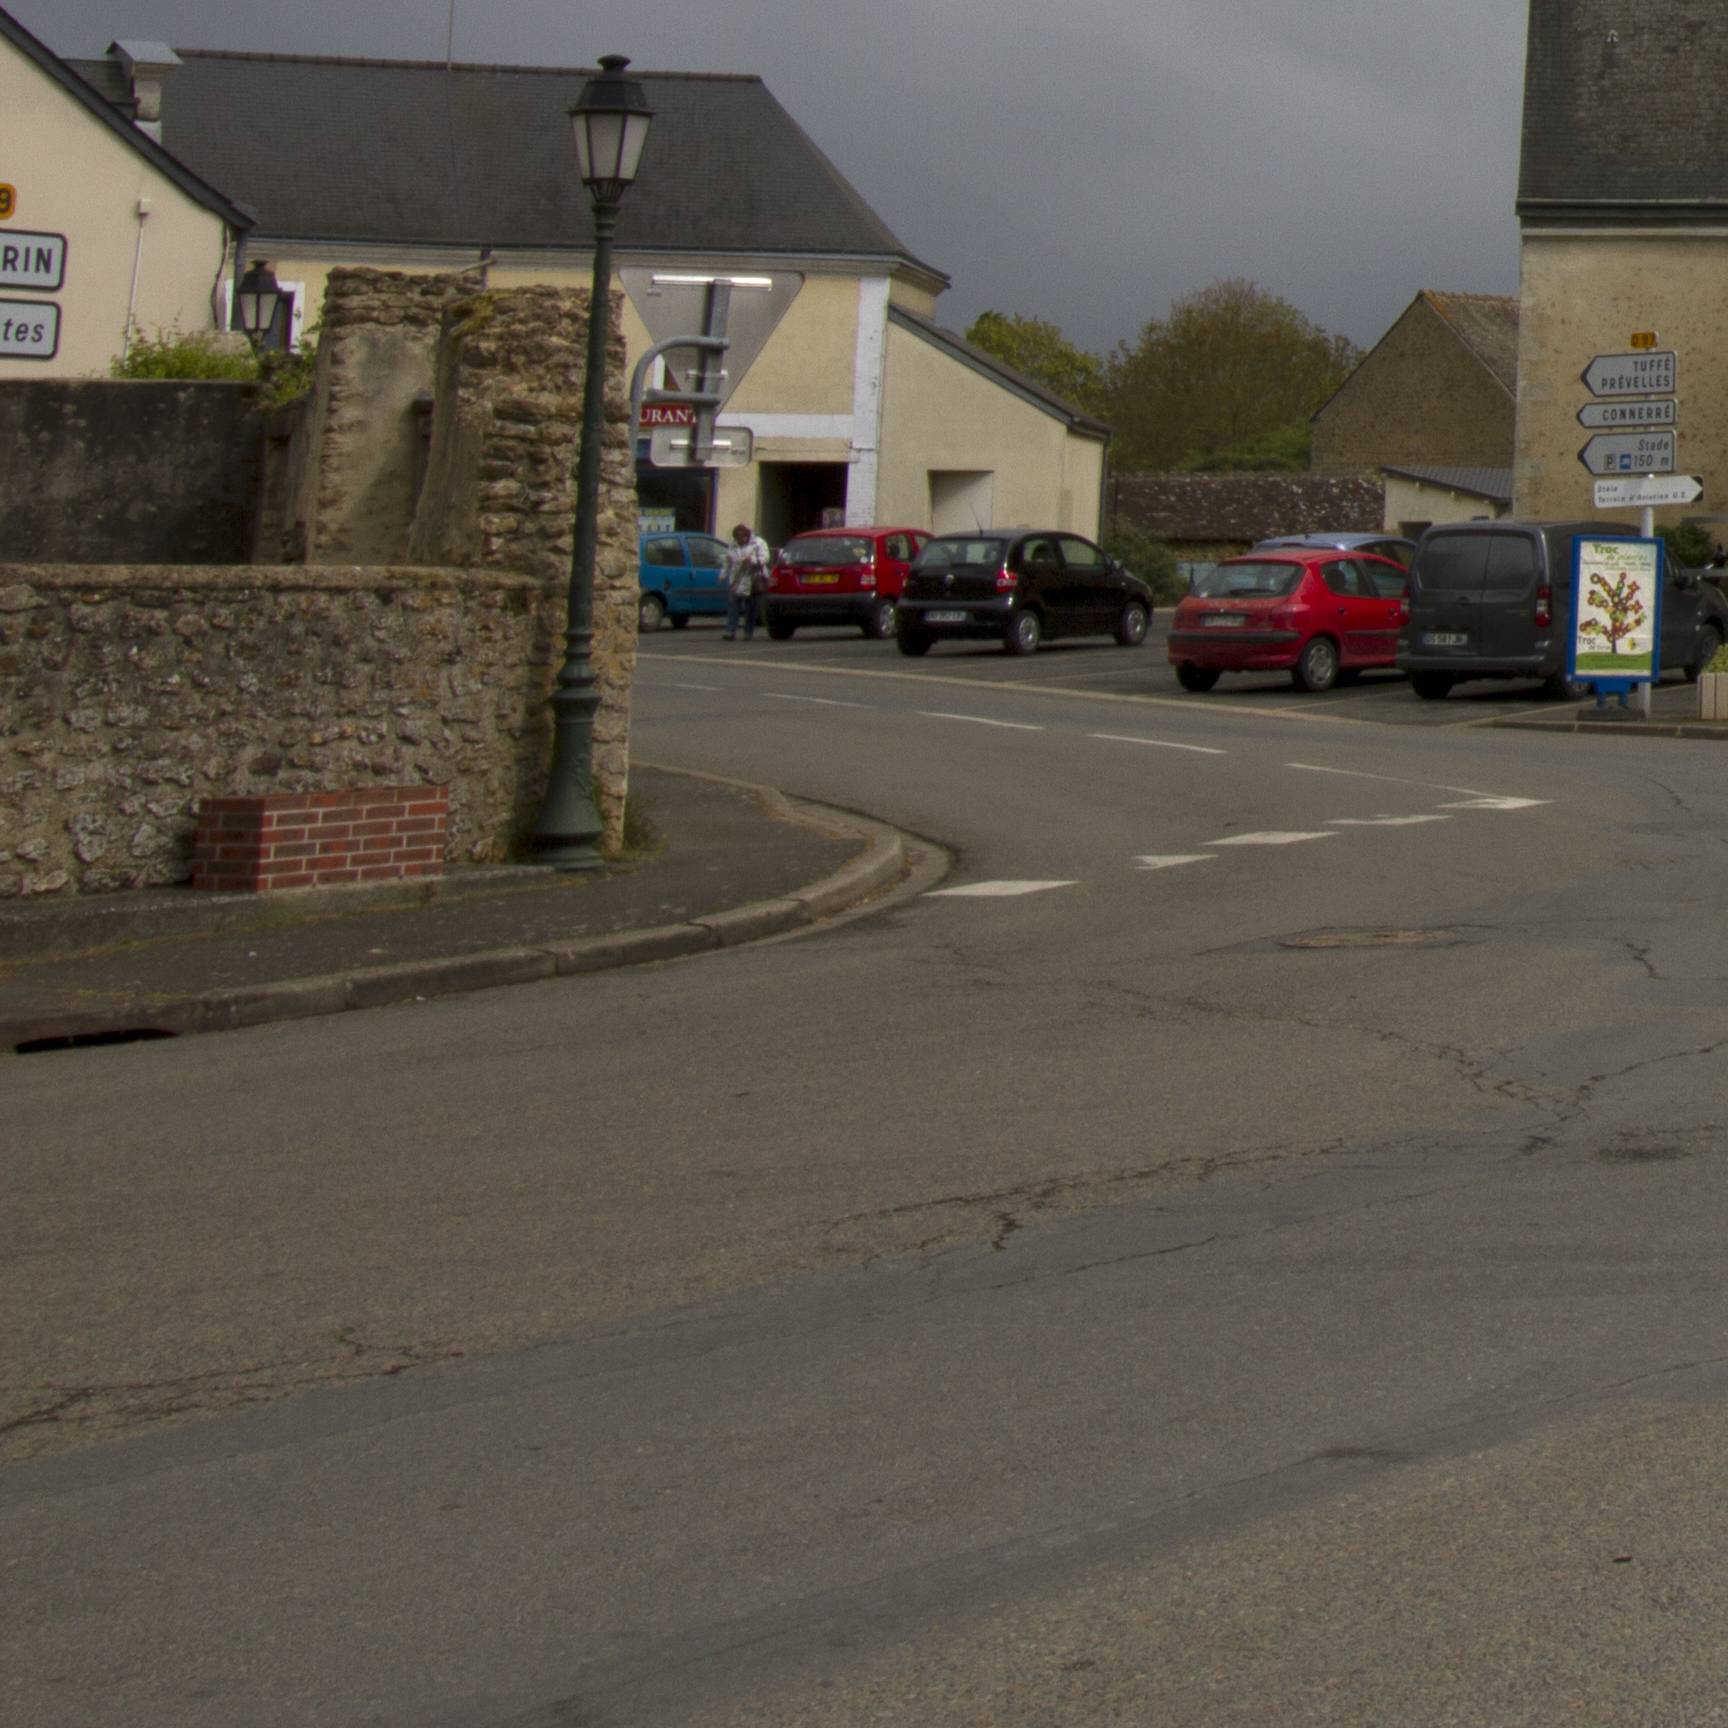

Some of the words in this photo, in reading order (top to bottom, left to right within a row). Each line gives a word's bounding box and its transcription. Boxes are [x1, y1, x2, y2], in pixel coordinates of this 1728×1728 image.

[1633, 356, 1671, 372] TUFFÉ
[1601, 374, 1670, 390] PRÉVELLES
[1602, 404, 1670, 421] CONNERRÉ
[1638, 438, 1669, 452] Stade
[1634, 454, 1653, 467] 150
[1592, 543, 1618, 553] Troc
